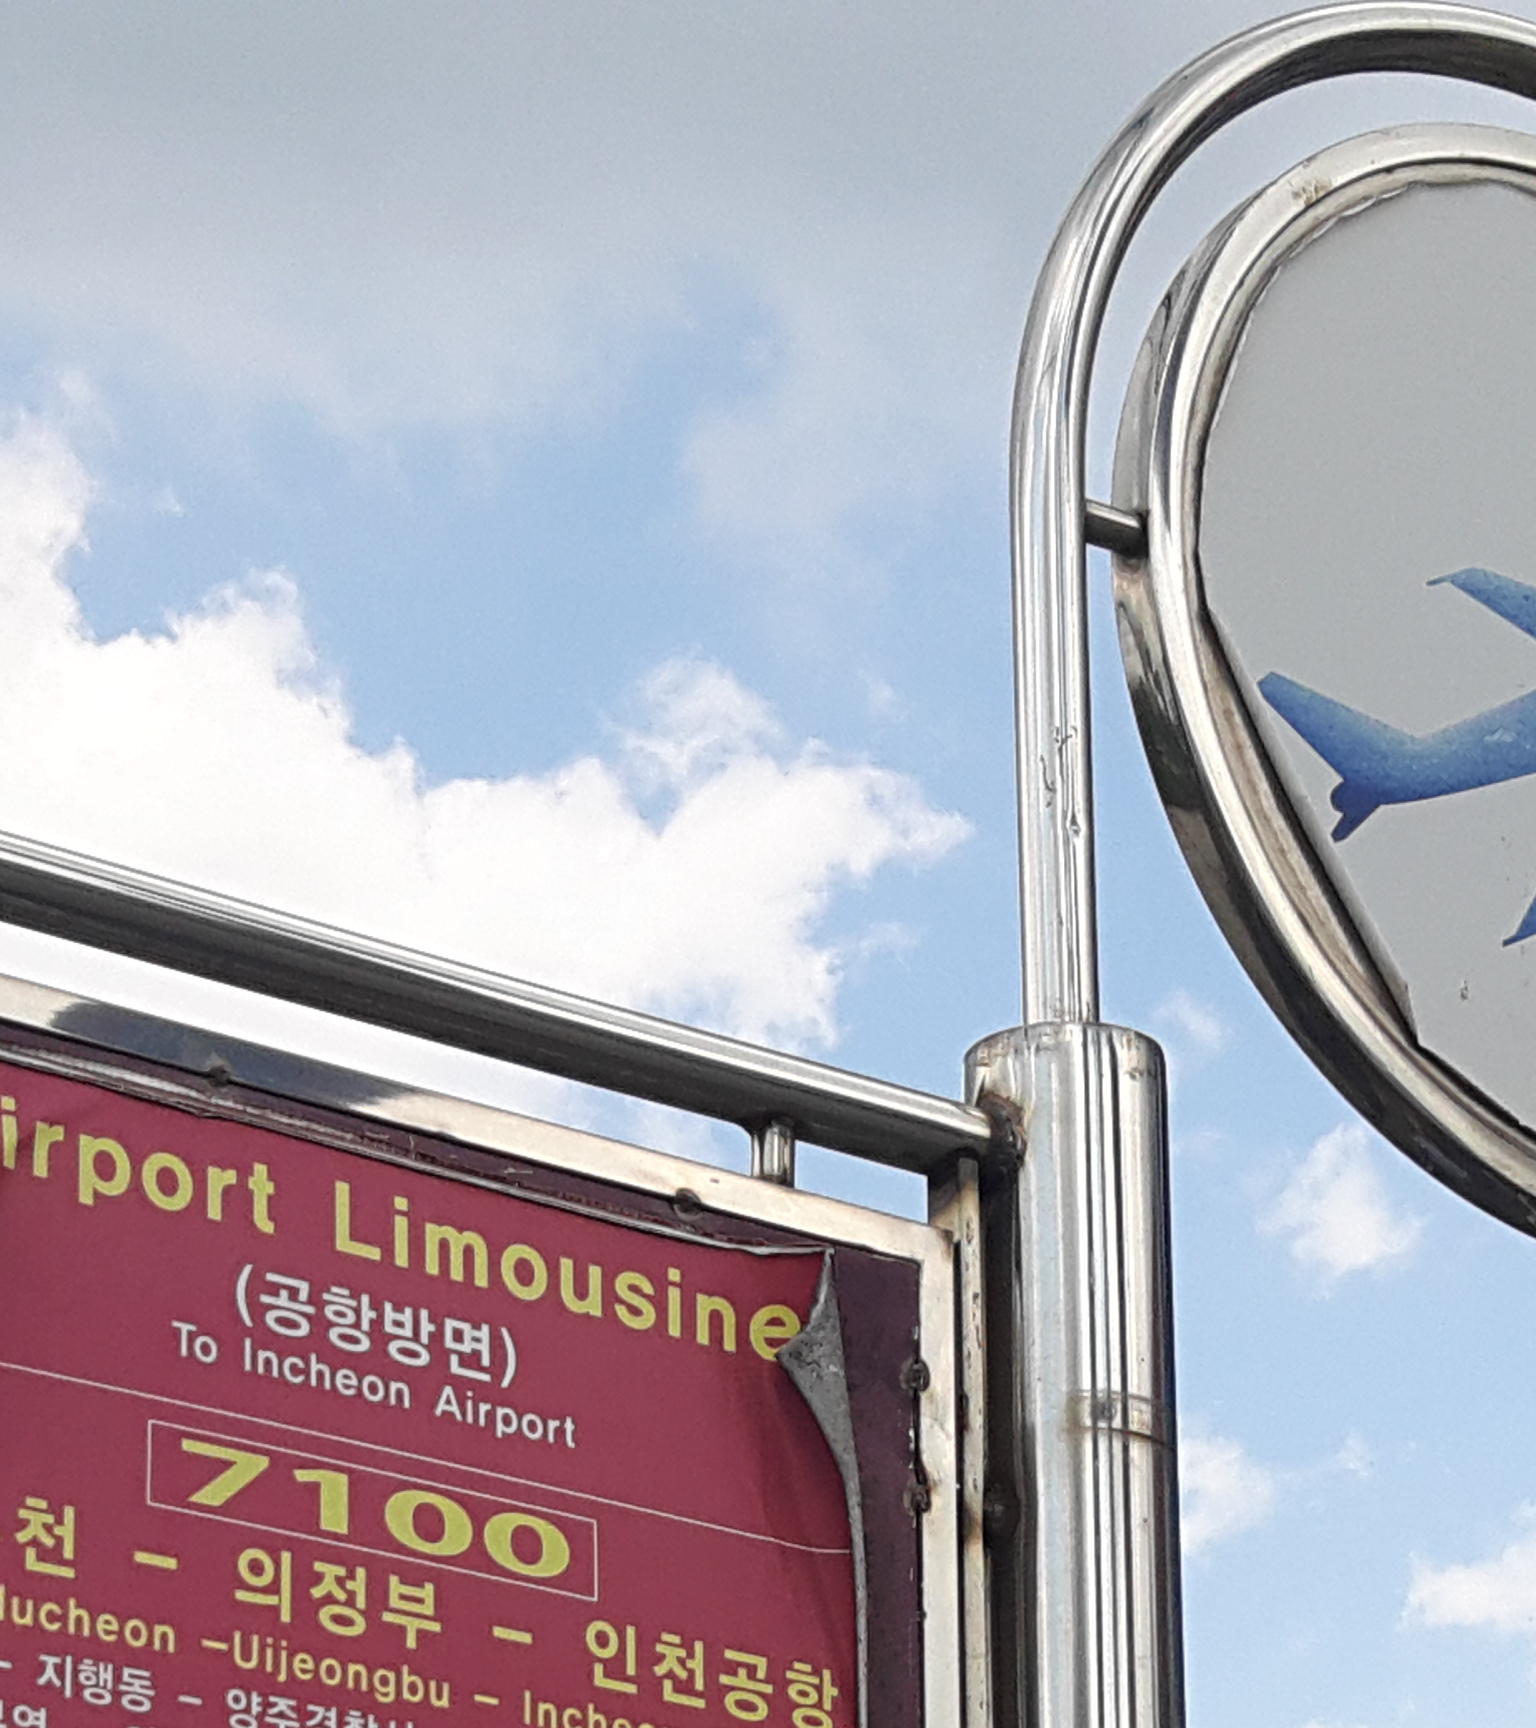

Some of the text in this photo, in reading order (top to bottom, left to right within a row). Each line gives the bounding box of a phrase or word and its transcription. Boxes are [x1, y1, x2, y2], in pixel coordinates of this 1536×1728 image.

[234, 1261, 518, 1389] (공항방면)
[333, 1178, 802, 1361] Limousine
[171, 1320, 577, 1449] To Incheon Airport
[180, 1437, 571, 1579] 7100
[233, 1547, 442, 1650] 의정부
[37, 1652, 156, 1714] 지행동
